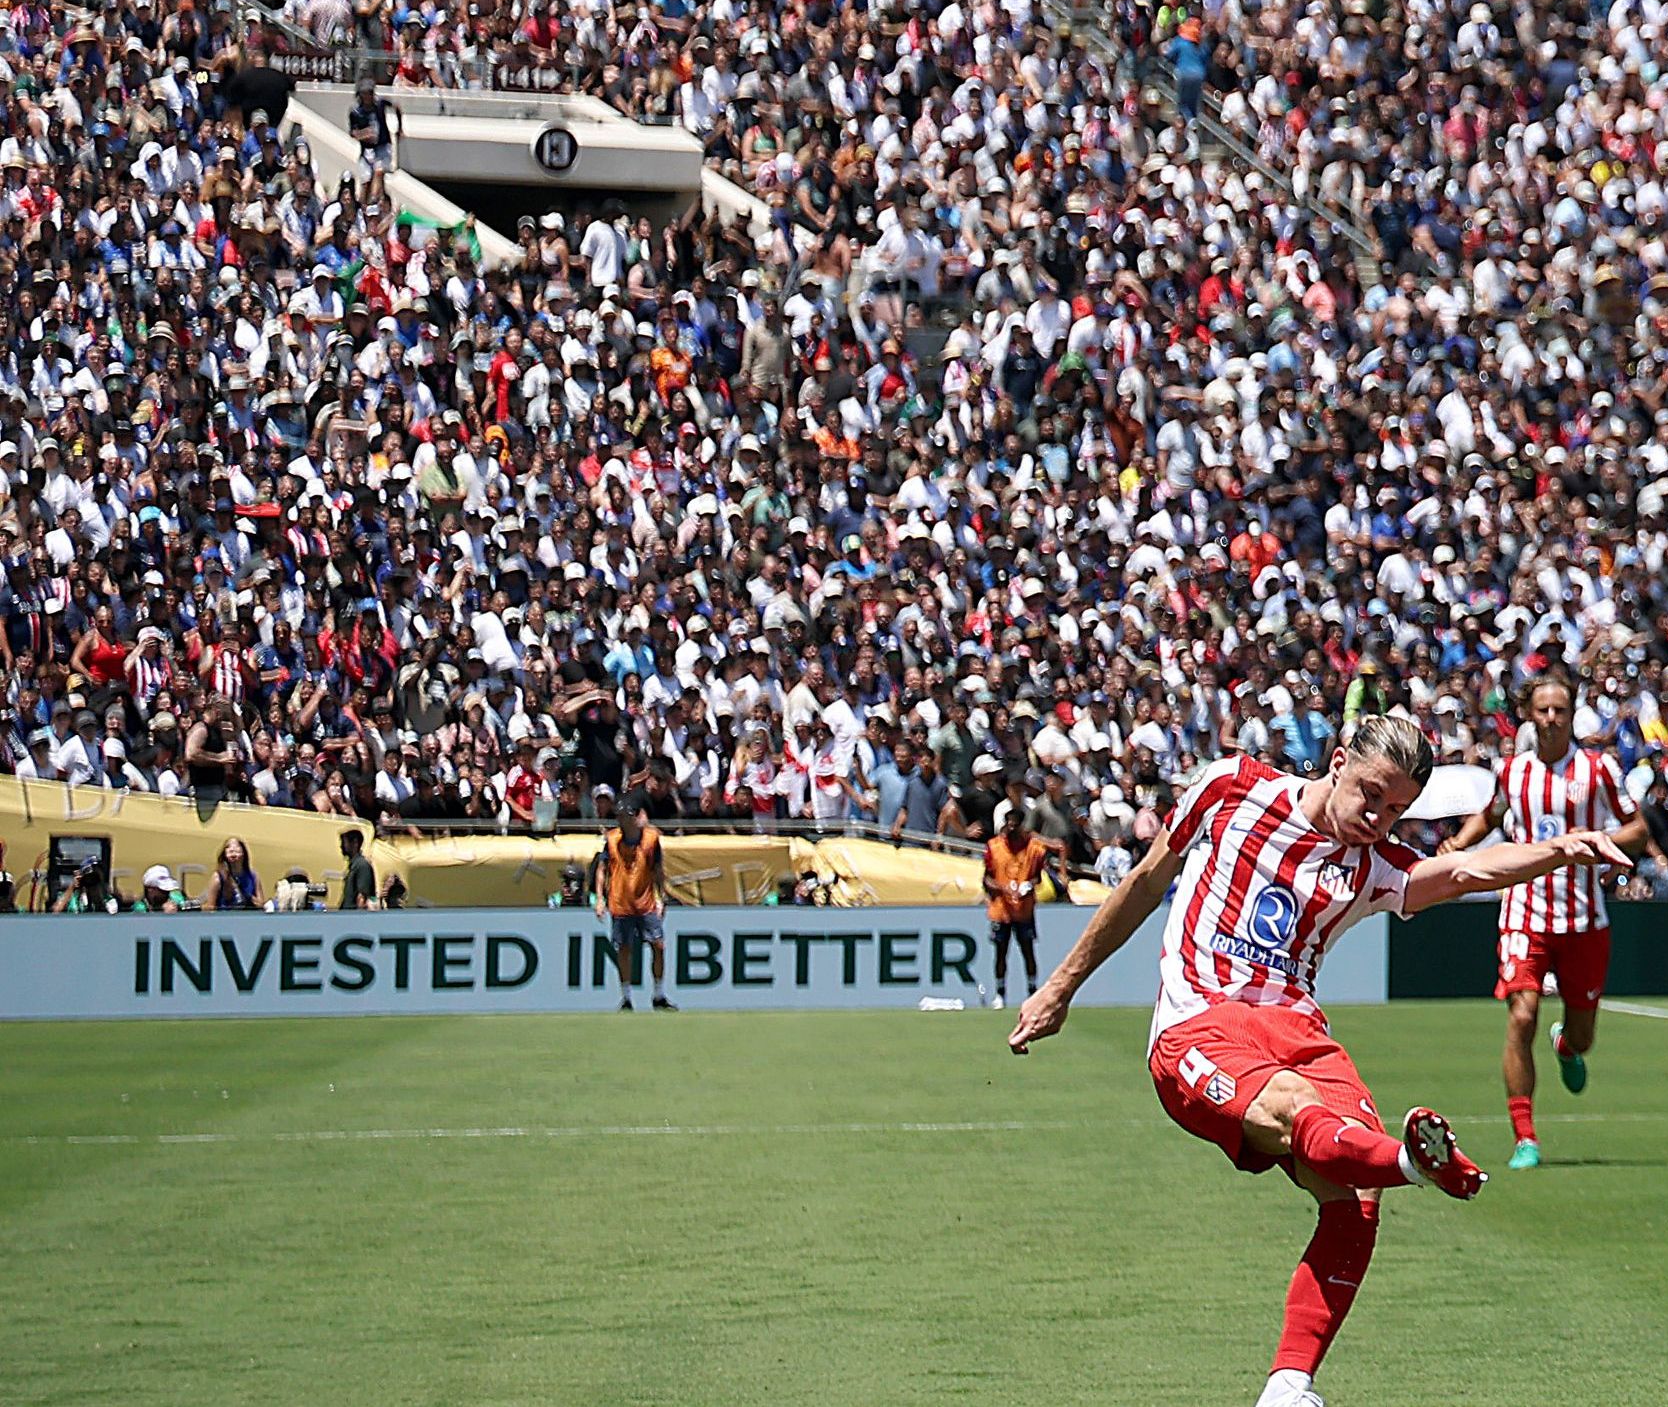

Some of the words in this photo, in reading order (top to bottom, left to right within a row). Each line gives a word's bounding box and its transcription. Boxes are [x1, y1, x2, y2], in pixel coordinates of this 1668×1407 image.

[135, 935, 540, 993] INVESTED
[568, 935, 641, 987] IN
[677, 932, 978, 986] BETTER
[1211, 932, 1276, 968] RIYADH
[1178, 1045, 1218, 1089] 4
